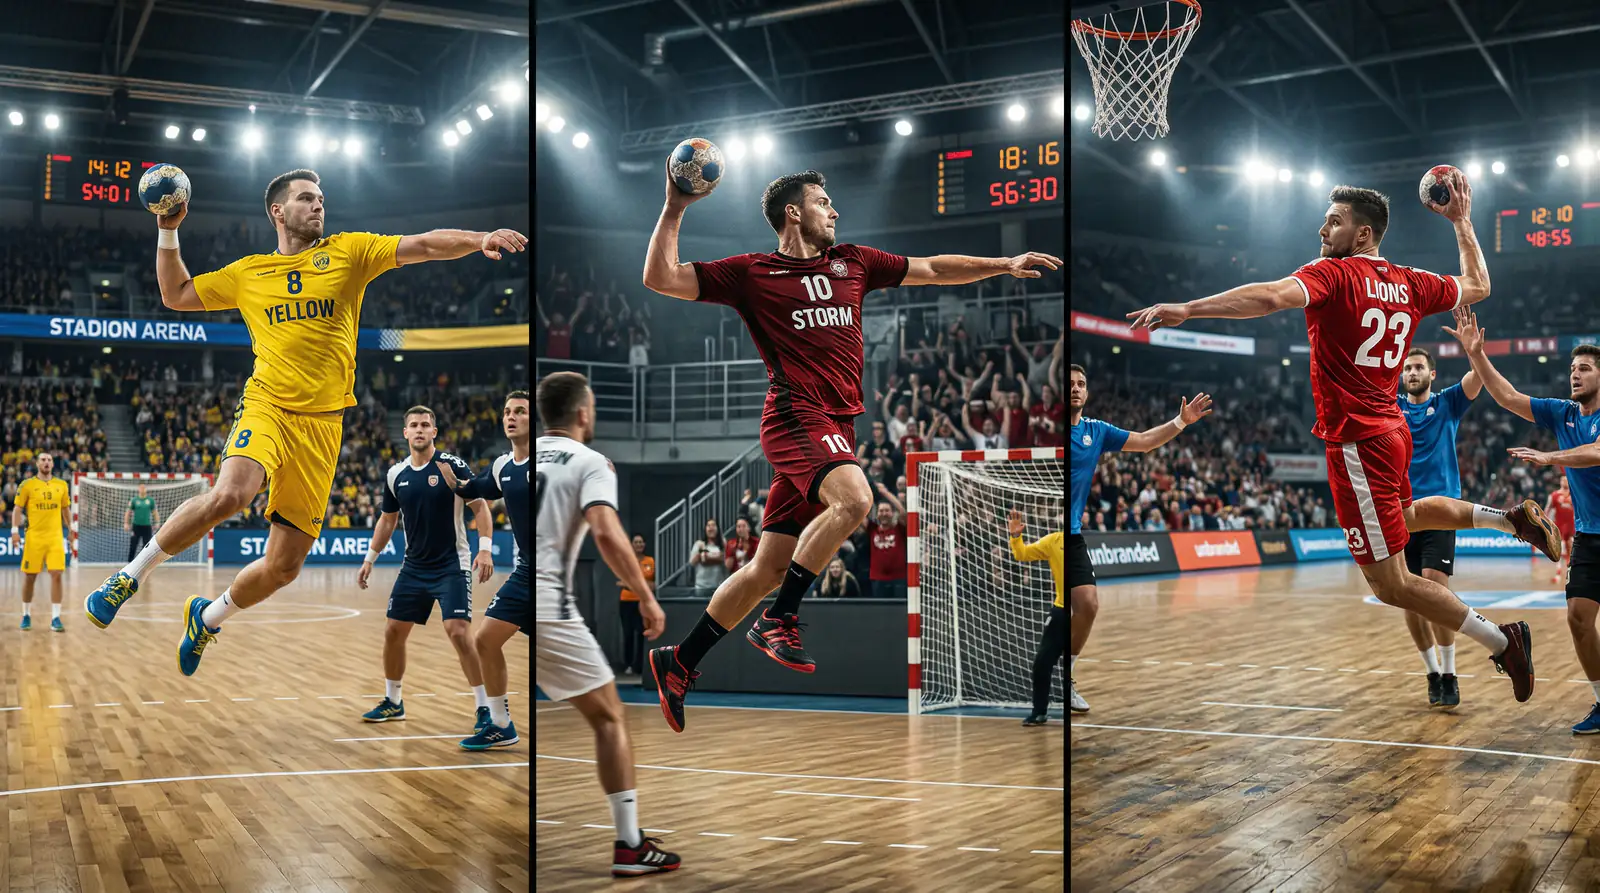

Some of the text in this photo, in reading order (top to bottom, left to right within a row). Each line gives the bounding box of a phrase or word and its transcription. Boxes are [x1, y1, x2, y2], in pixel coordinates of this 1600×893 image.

[82, 183, 130, 203] 54:01
[989, 176, 1058, 207] 56:30
[1525, 228, 1573, 248] 48:55
[286, 270, 303, 295] 8
[800, 274, 834, 302] 10
[1364, 276, 1410, 305] LIONS
[264, 299, 335, 326] YELLOW
[791, 306, 853, 330] STORM
[49, 317, 207, 342] STADION ARENA
[1354, 307, 1412, 369] 23
[234, 428, 253, 449] 8
[821, 433, 852, 454] 10
